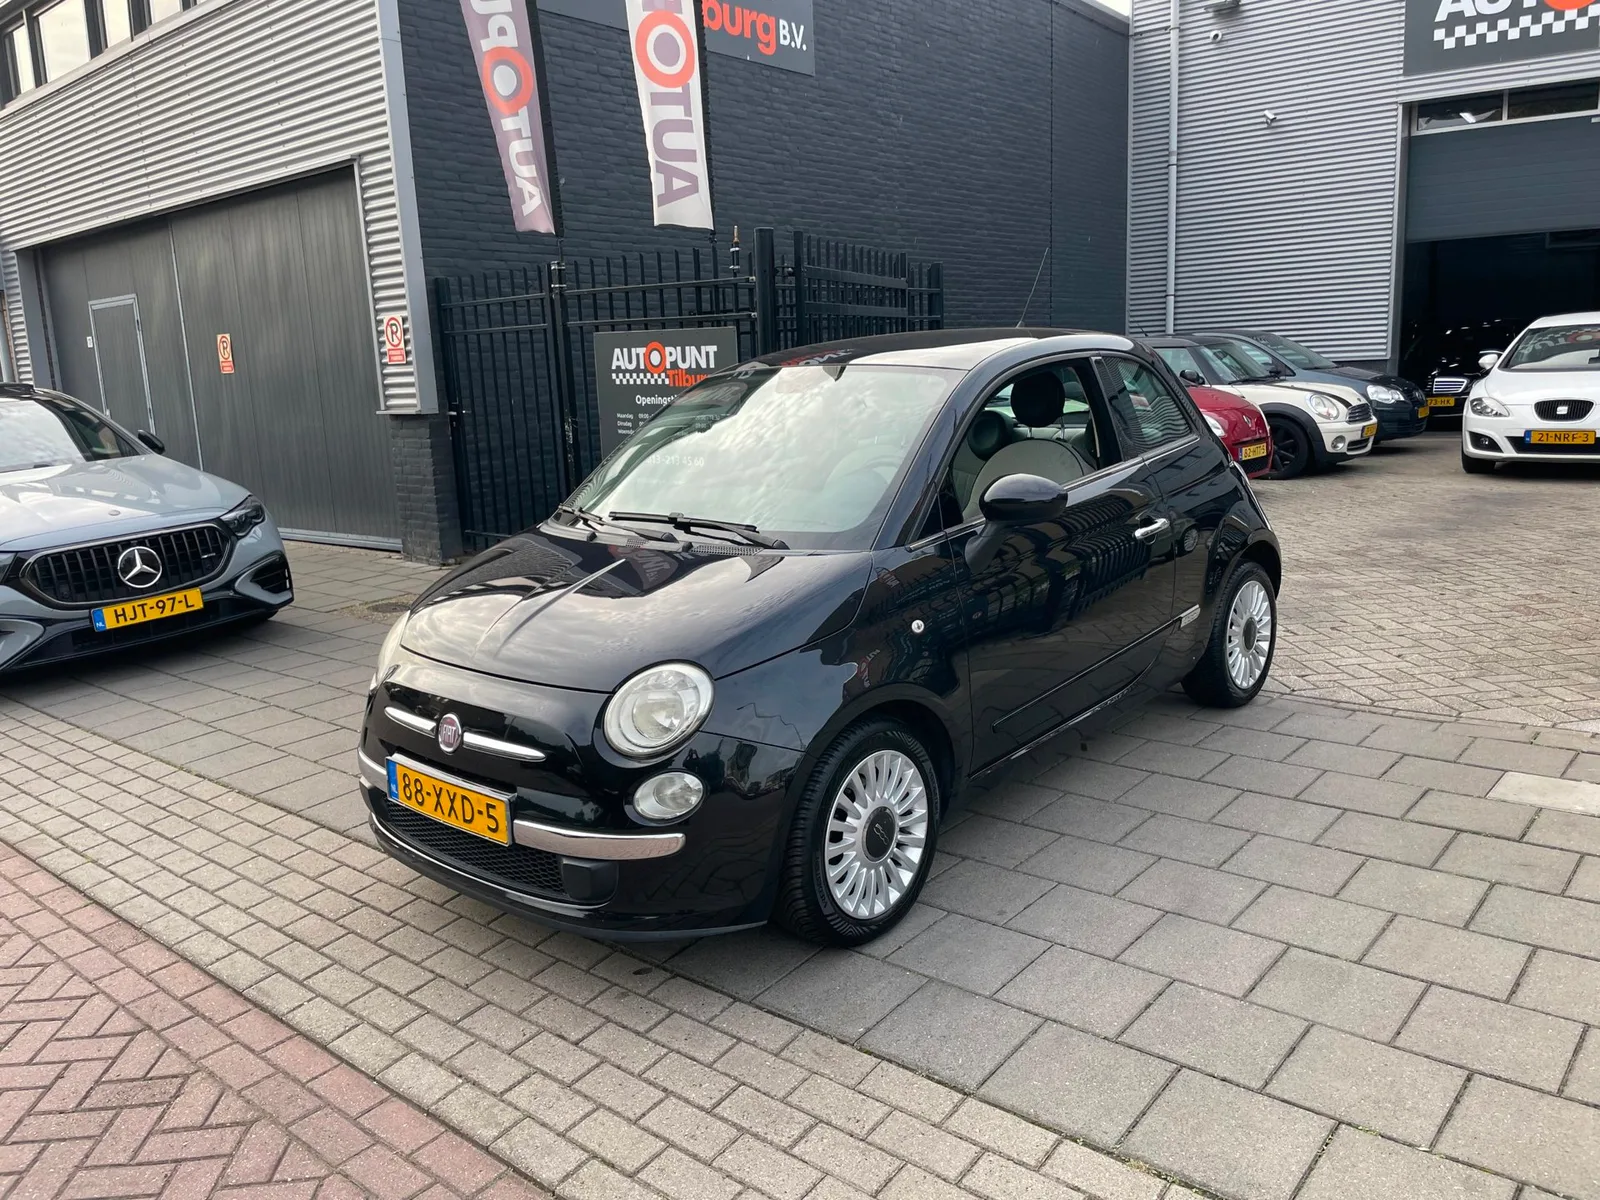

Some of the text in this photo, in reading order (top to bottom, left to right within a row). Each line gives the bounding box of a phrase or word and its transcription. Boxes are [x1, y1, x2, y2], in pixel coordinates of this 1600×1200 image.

[779, 18, 807, 51] B.V.
[611, 341, 717, 375] AUTOPUNT
[666, 369, 708, 387] Tilbu
[1537, 433, 1589, 442] 21-NRF-3
[114, 594, 195, 624] HJT-97-L
[402, 772, 500, 834] 88-XXD-5
